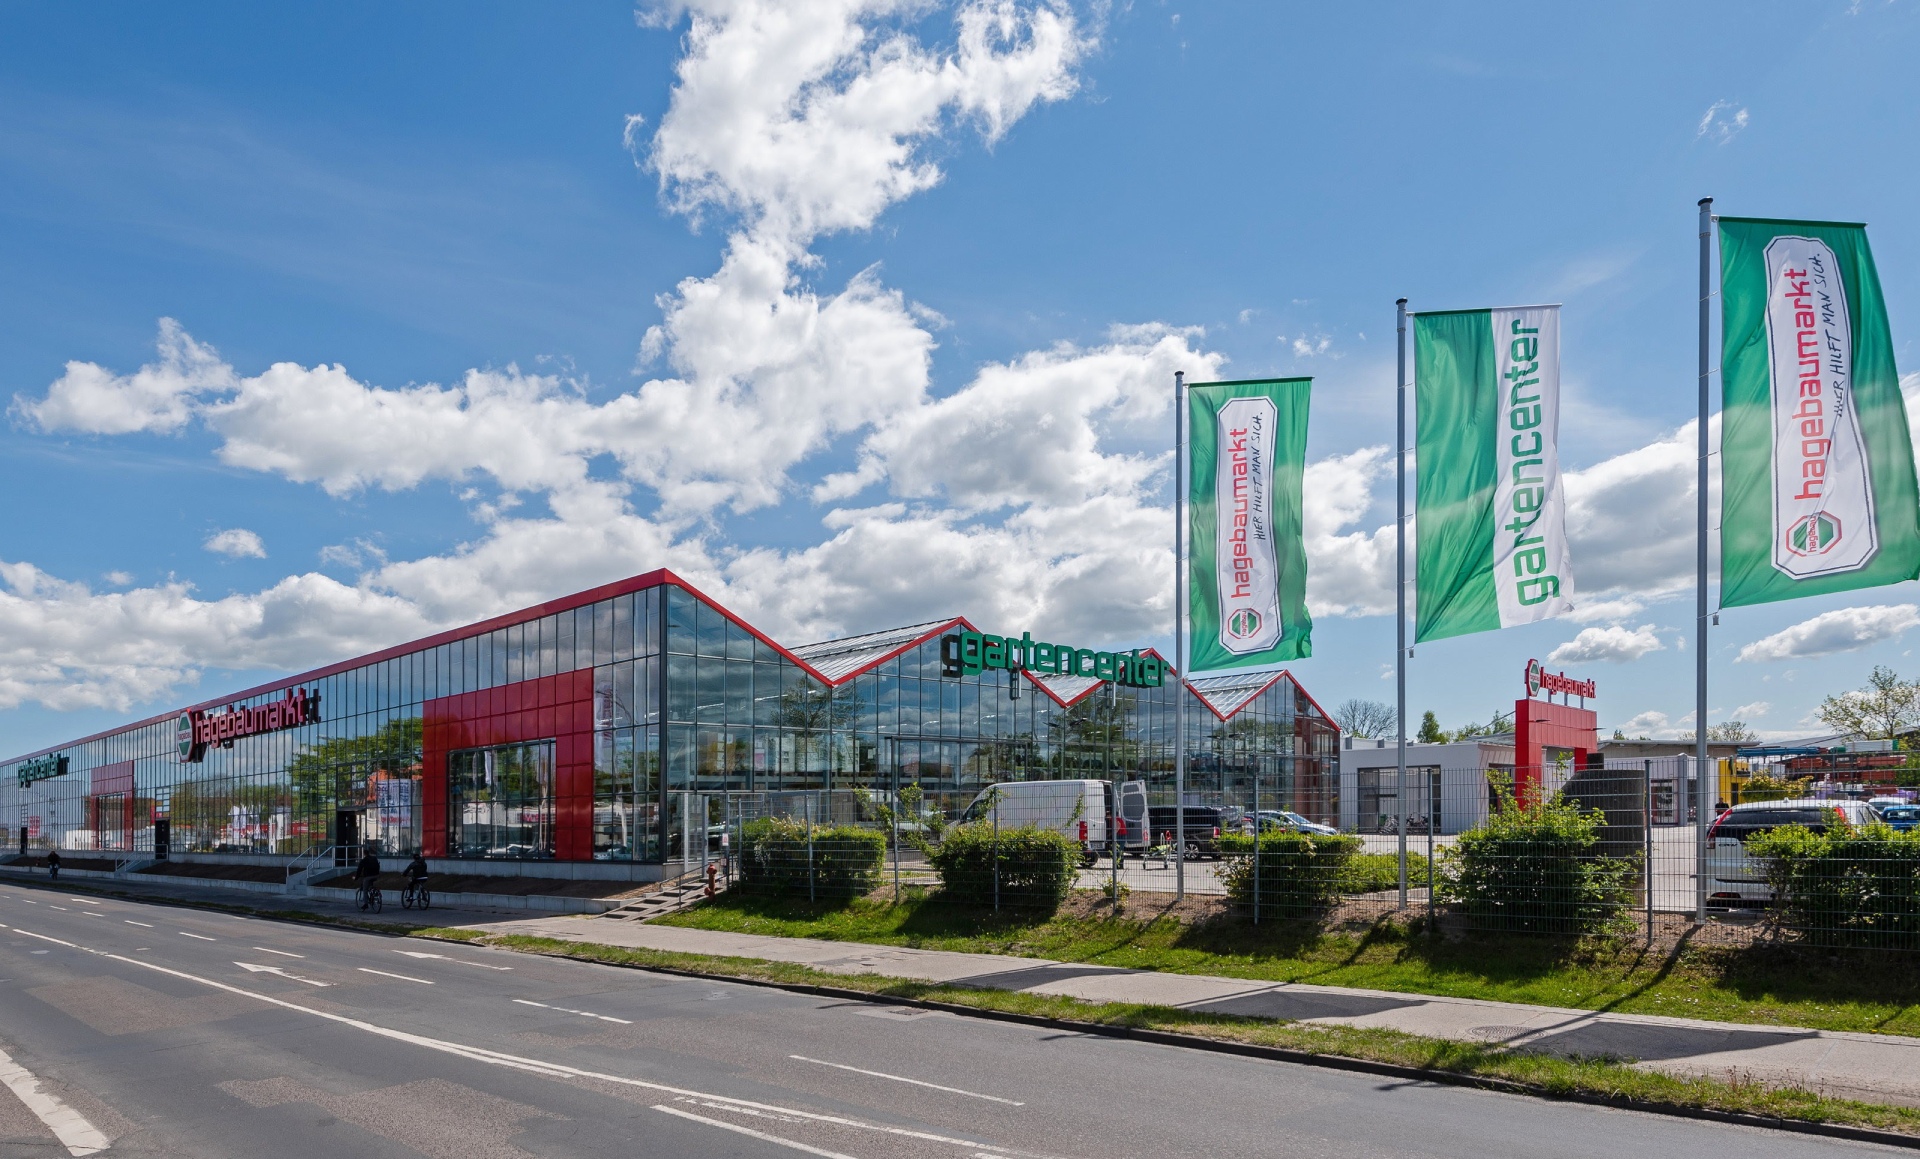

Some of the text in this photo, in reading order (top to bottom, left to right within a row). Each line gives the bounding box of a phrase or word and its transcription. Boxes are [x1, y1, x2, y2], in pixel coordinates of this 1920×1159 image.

[1808, 253, 1827, 288] SICH.
[1817, 290, 1836, 326] MAN
[1825, 328, 1846, 376] HILFT
[1784, 268, 1831, 500] hagebaumarkt
[1251, 412, 1266, 540] HIER HILFT MAN SICH.
[1504, 319, 1560, 606] gartencenter
[1227, 428, 1253, 599] hagebaumarkt
[961, 631, 1170, 688] gartencenter
[1540, 666, 1596, 698] hagebaumarkt
[195, 687, 306, 749] hagebaumarkt
